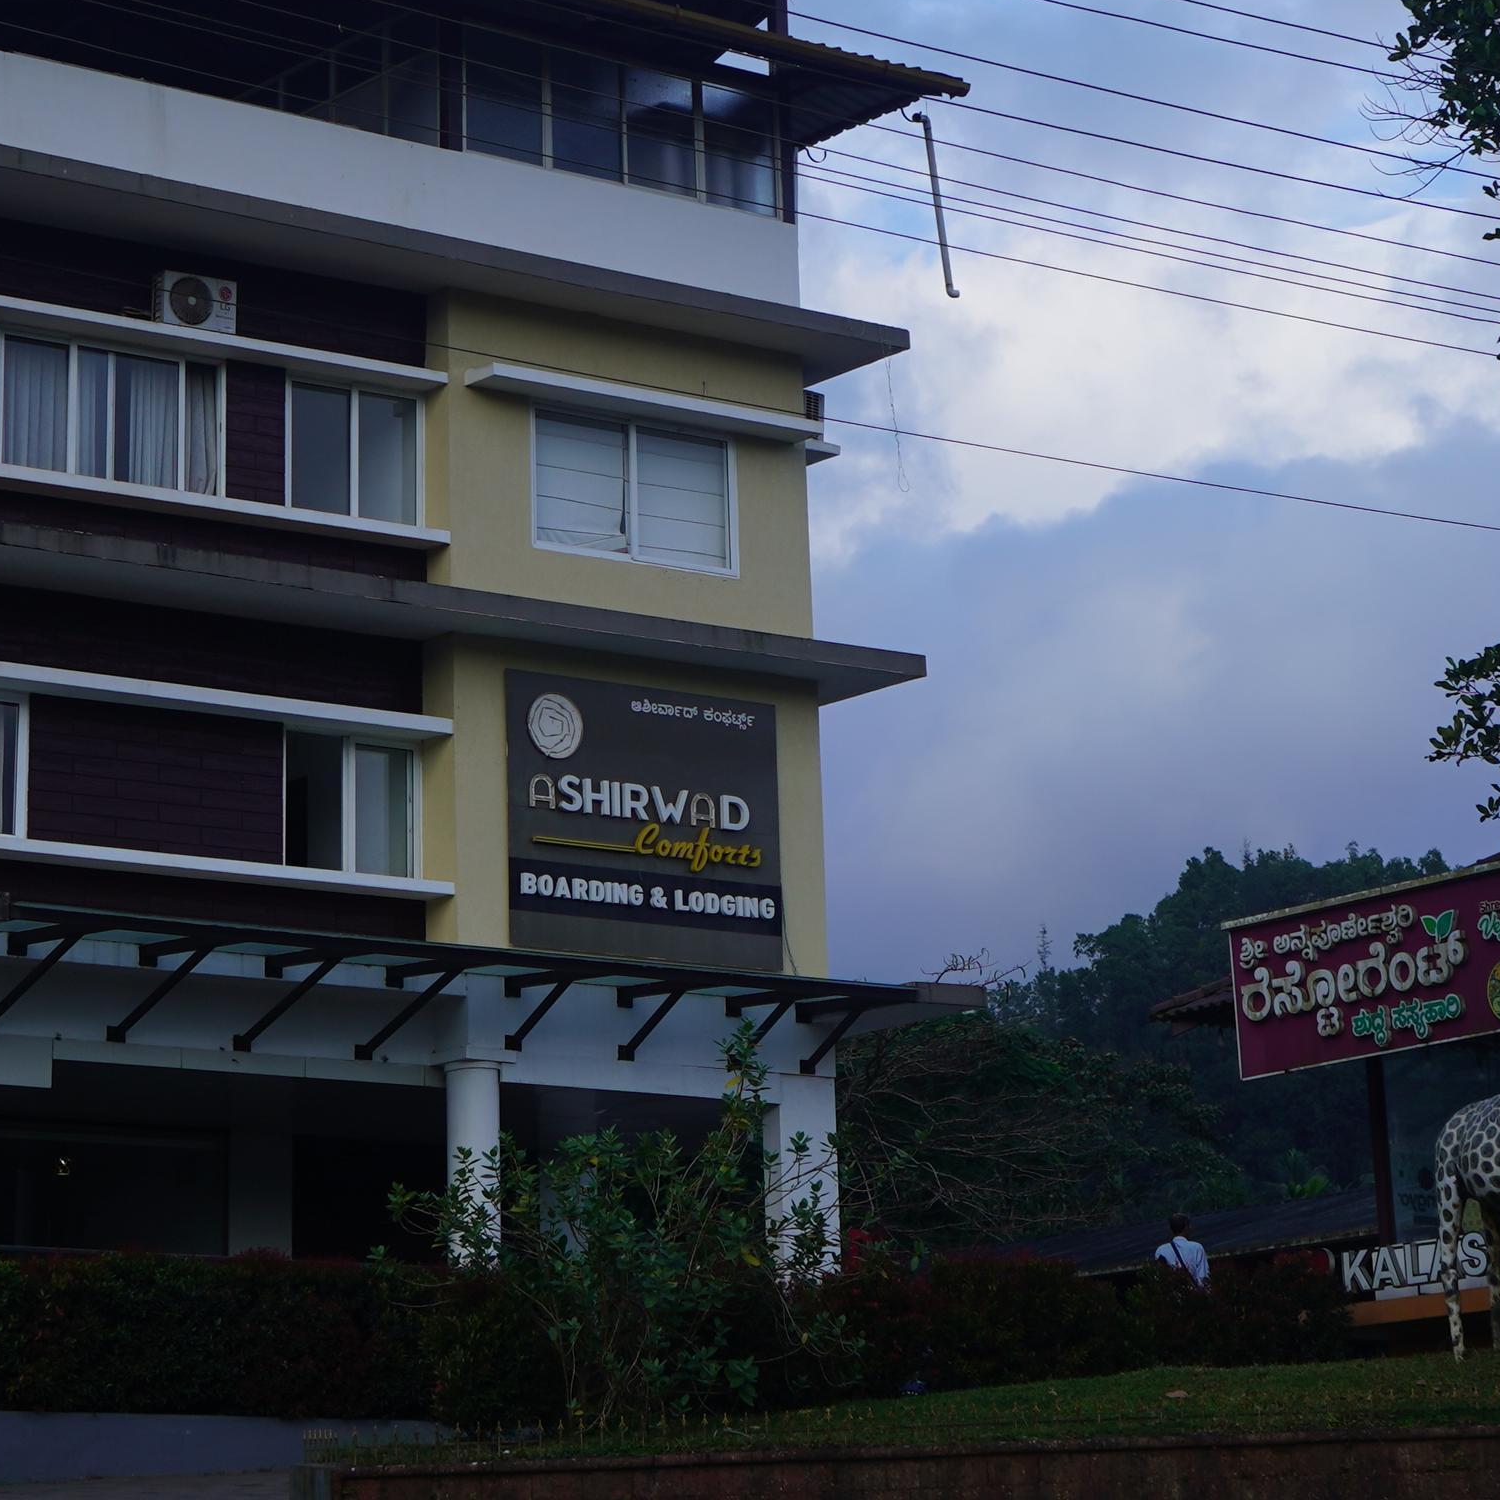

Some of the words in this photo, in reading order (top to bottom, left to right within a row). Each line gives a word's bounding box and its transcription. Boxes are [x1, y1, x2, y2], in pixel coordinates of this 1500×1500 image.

[528, 773, 751, 831] ASHIRWAD
[634, 823, 762, 872] Comforts
[520, 872, 644, 907] BOARDING
[650, 886, 668, 909] &
[674, 889, 776, 919] LODGING
